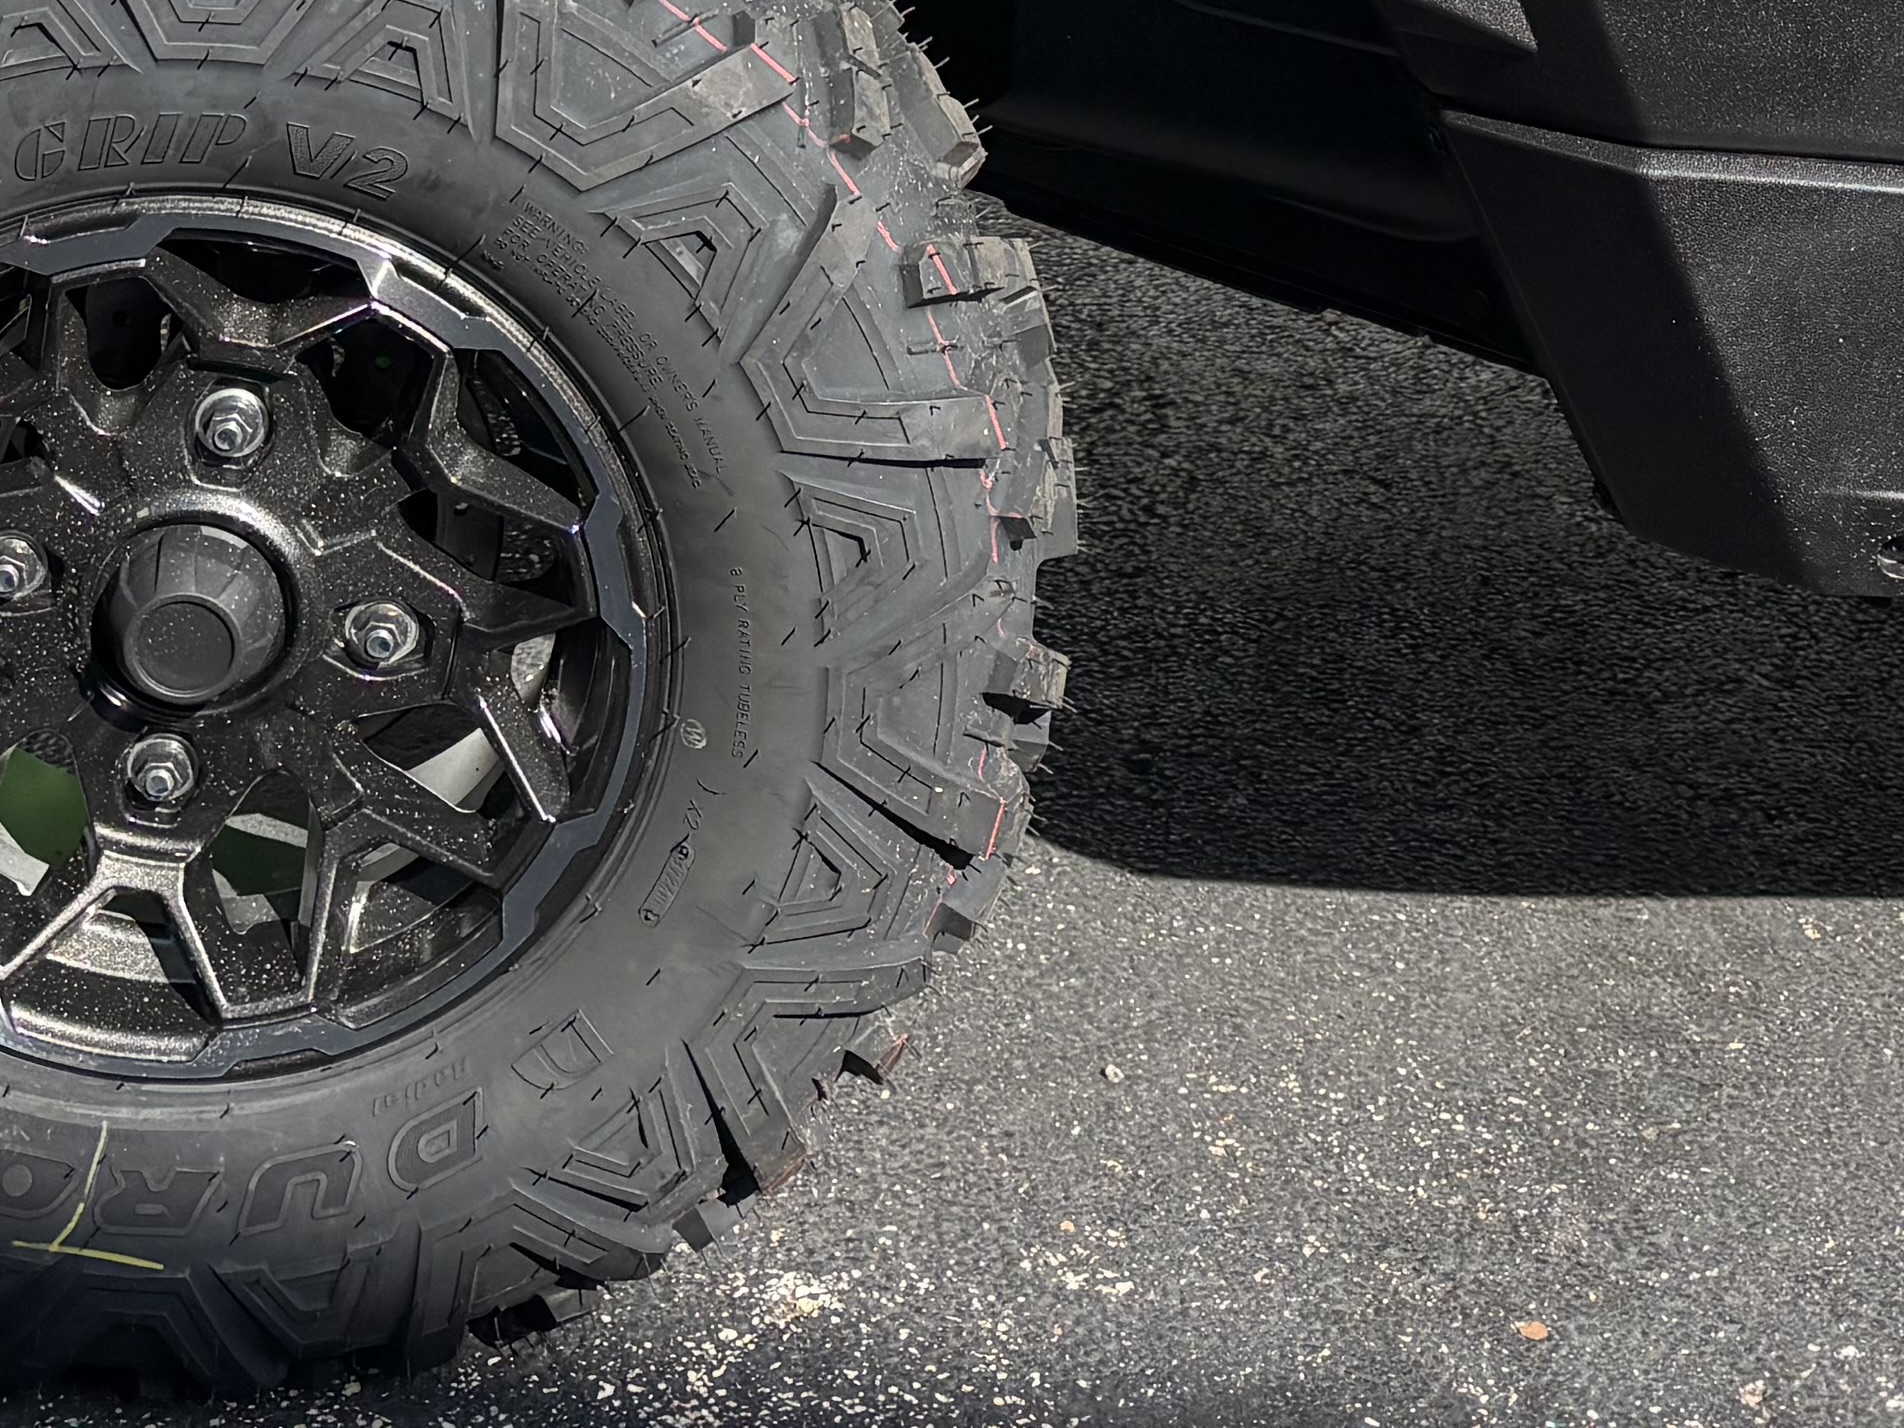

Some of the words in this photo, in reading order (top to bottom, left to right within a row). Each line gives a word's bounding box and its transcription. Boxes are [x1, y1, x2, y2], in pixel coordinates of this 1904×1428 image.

[14, 111, 249, 183] GRIP
[285, 122, 411, 202] V2
[731, 583, 749, 613] PLY
[734, 617, 753, 677] RATING
[725, 682, 756, 761] TUBELESS
